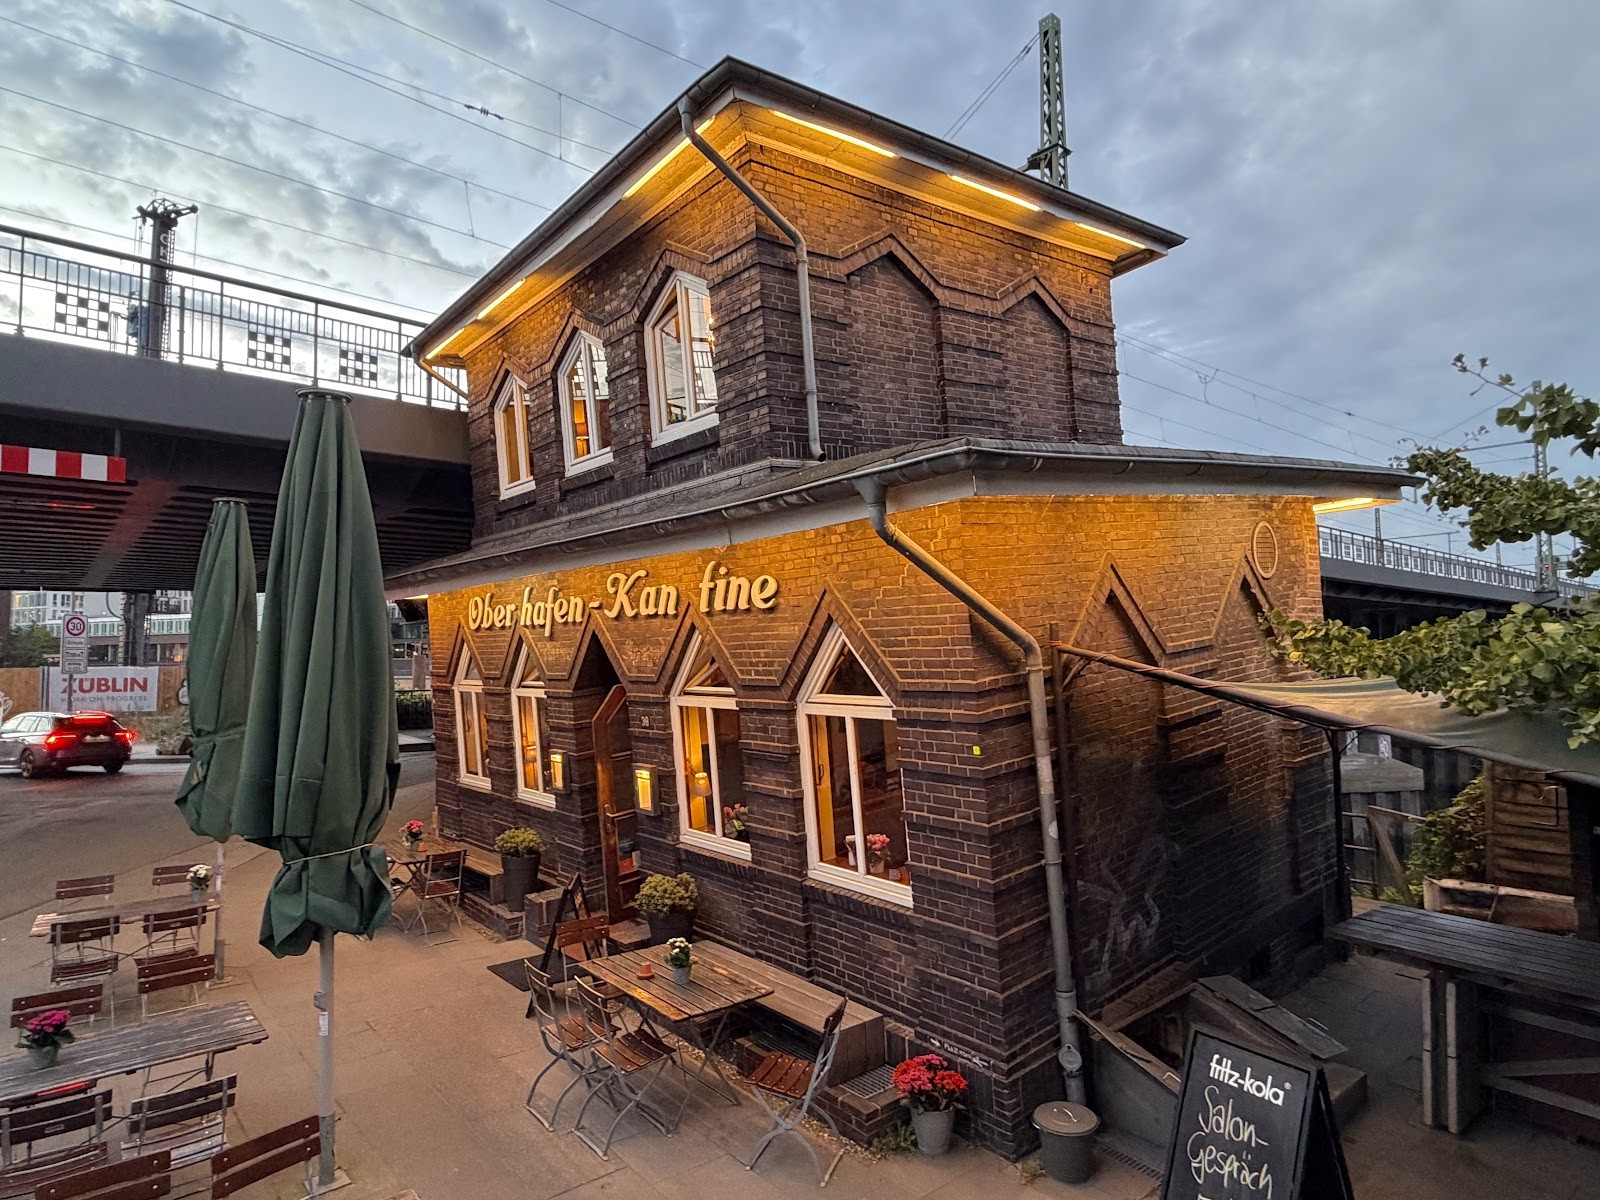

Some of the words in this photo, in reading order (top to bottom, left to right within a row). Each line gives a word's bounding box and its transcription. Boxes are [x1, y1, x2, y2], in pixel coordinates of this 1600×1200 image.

[70, 622, 82, 631] 30
[640, 716, 650, 727] 39
[1199, 1085, 1269, 1147] Salon-
